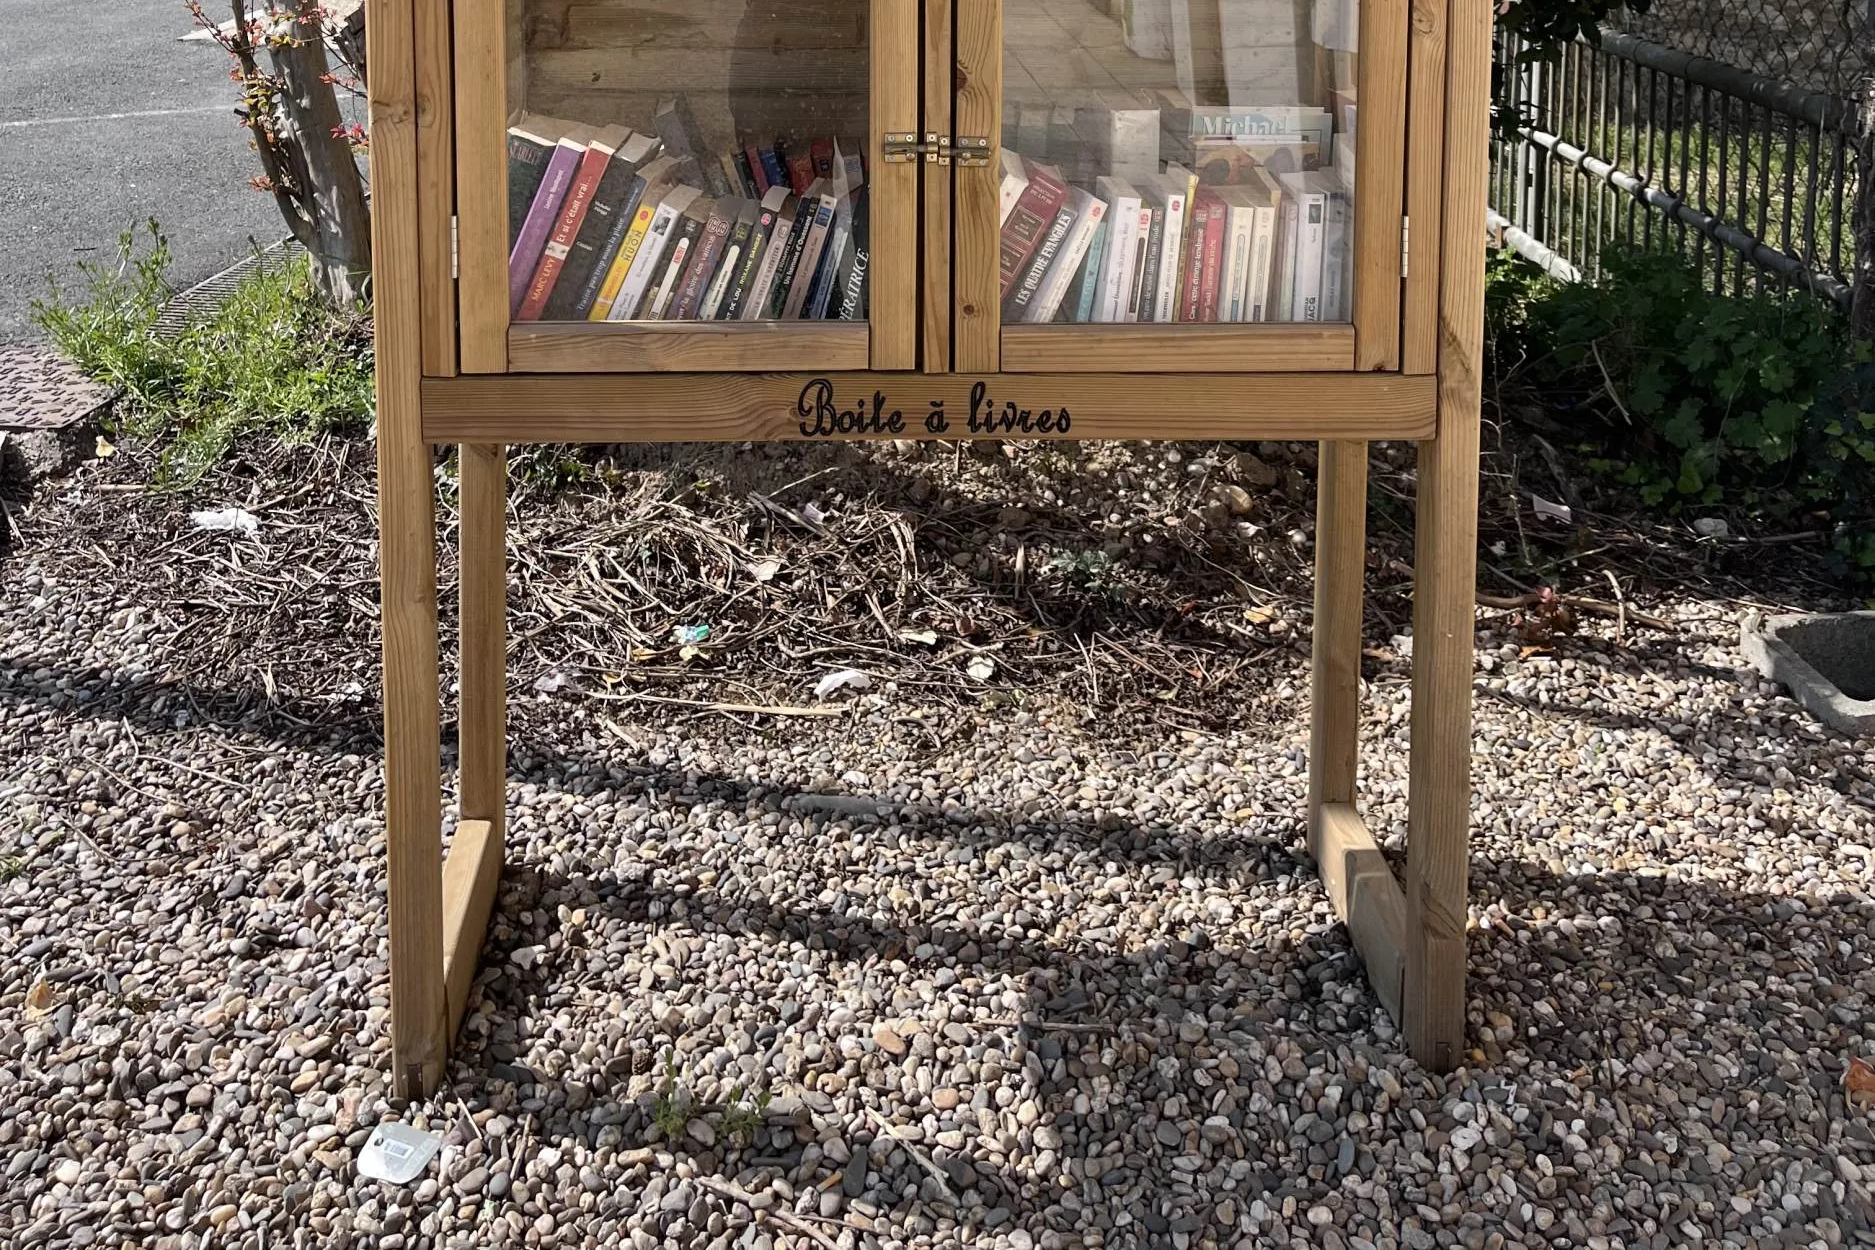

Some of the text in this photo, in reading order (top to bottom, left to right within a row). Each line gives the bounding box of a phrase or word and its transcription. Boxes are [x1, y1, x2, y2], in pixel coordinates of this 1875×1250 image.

[1202, 115, 1289, 135] Michael
[556, 234, 566, 242] Et
[566, 200, 580, 223] c'était
[624, 231, 642, 261] HUON
[784, 216, 812, 284] Un homme d'Ouessant
[1195, 229, 1203, 259] tendresse
[532, 258, 555, 300] MARC LEVY
[589, 276, 598, 289] pas
[687, 276, 698, 296] gloire
[695, 263, 704, 274] des
[702, 236, 715, 260] vaincus
[729, 302, 736, 310] DE
[740, 260, 752, 284] ROXANE
[1016, 289, 1030, 304] LES
[1025, 257, 1048, 289] QUATRE
[798, 378, 906, 437] Boite
[967, 381, 1072, 434] livres
